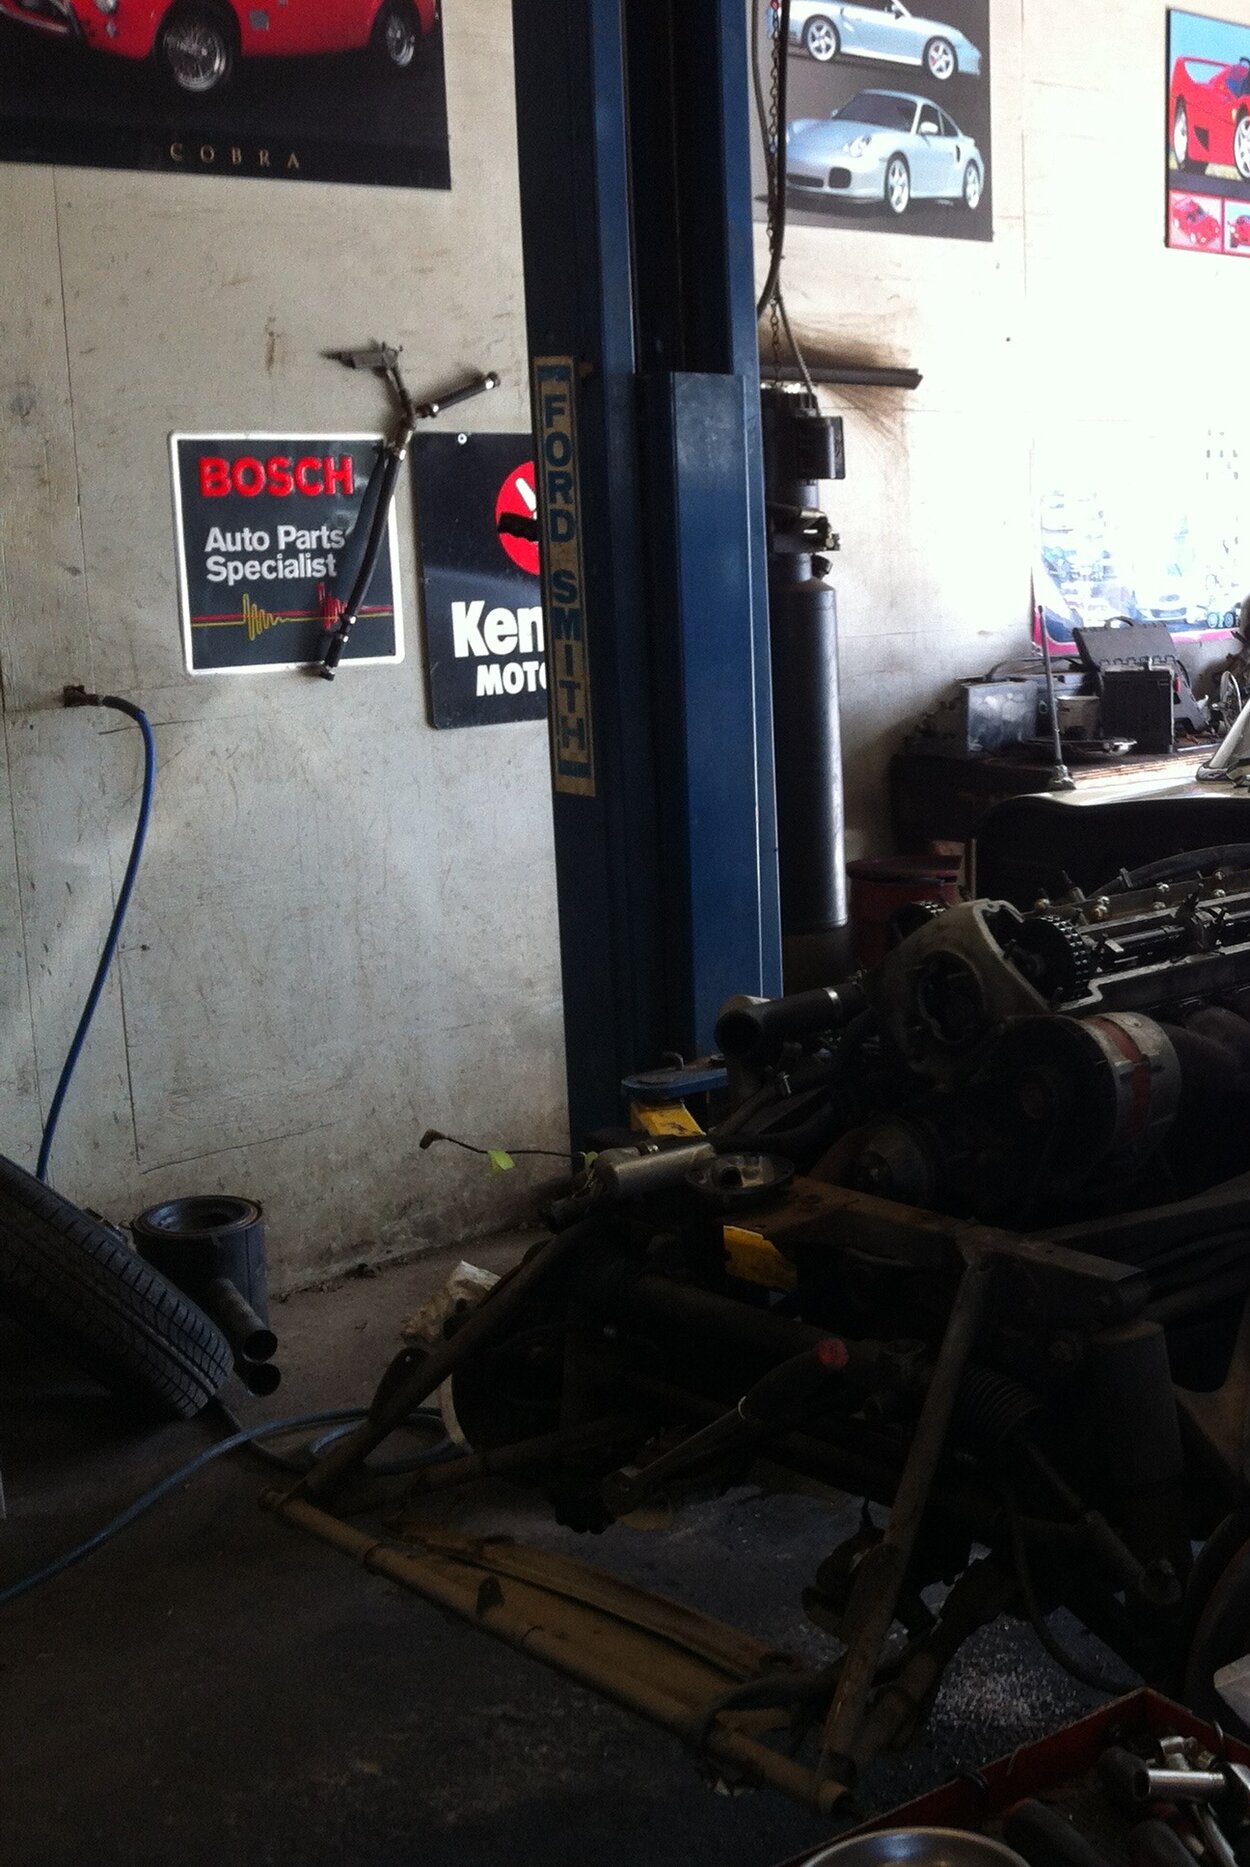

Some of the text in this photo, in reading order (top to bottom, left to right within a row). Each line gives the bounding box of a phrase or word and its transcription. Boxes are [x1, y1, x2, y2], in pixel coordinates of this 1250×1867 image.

[169, 141, 300, 169] COBRA
[198, 455, 354, 497] BOSCH
[204, 525, 346, 552] Auto Parts
[206, 553, 337, 586] Specialist
[544, 394, 587, 749] FORD SMITH
